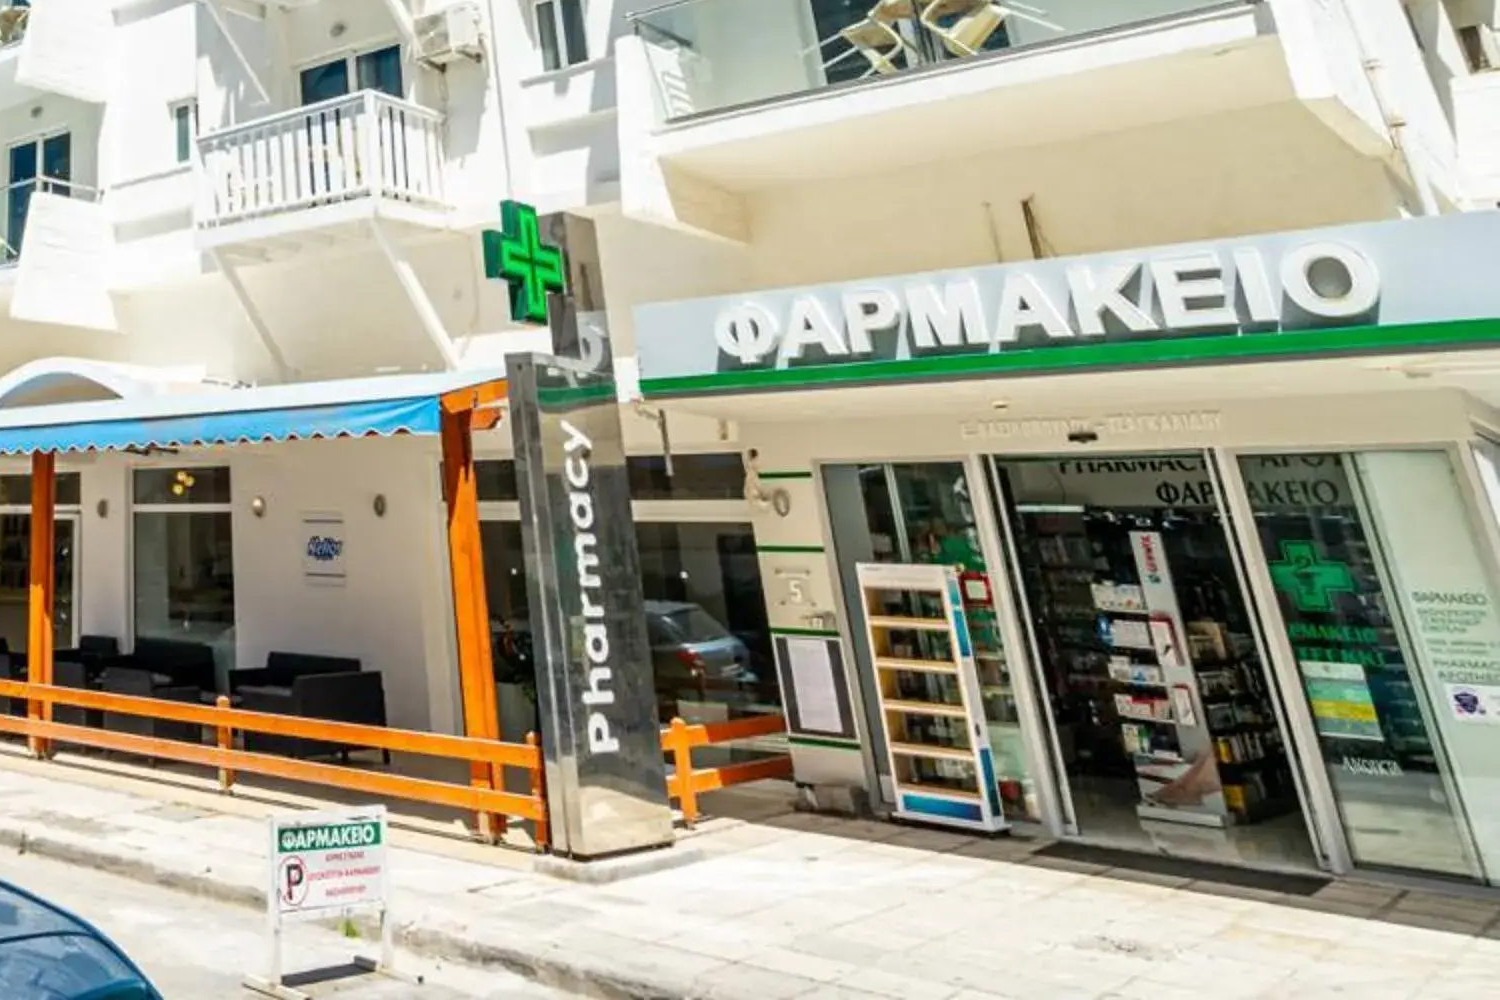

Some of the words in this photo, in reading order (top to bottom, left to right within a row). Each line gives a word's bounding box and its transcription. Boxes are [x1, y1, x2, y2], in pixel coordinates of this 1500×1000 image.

[715, 241, 1380, 364] ΦΑΡΜΑΚΕΙΟ
[1155, 479, 1340, 506] ΦΑΡΑΚΕΙΟ
[561, 420, 621, 756] Pharmacy
[789, 579, 803, 602] 5
[282, 824, 375, 850] ΦΑΡΜΑΚΕΙΟ
